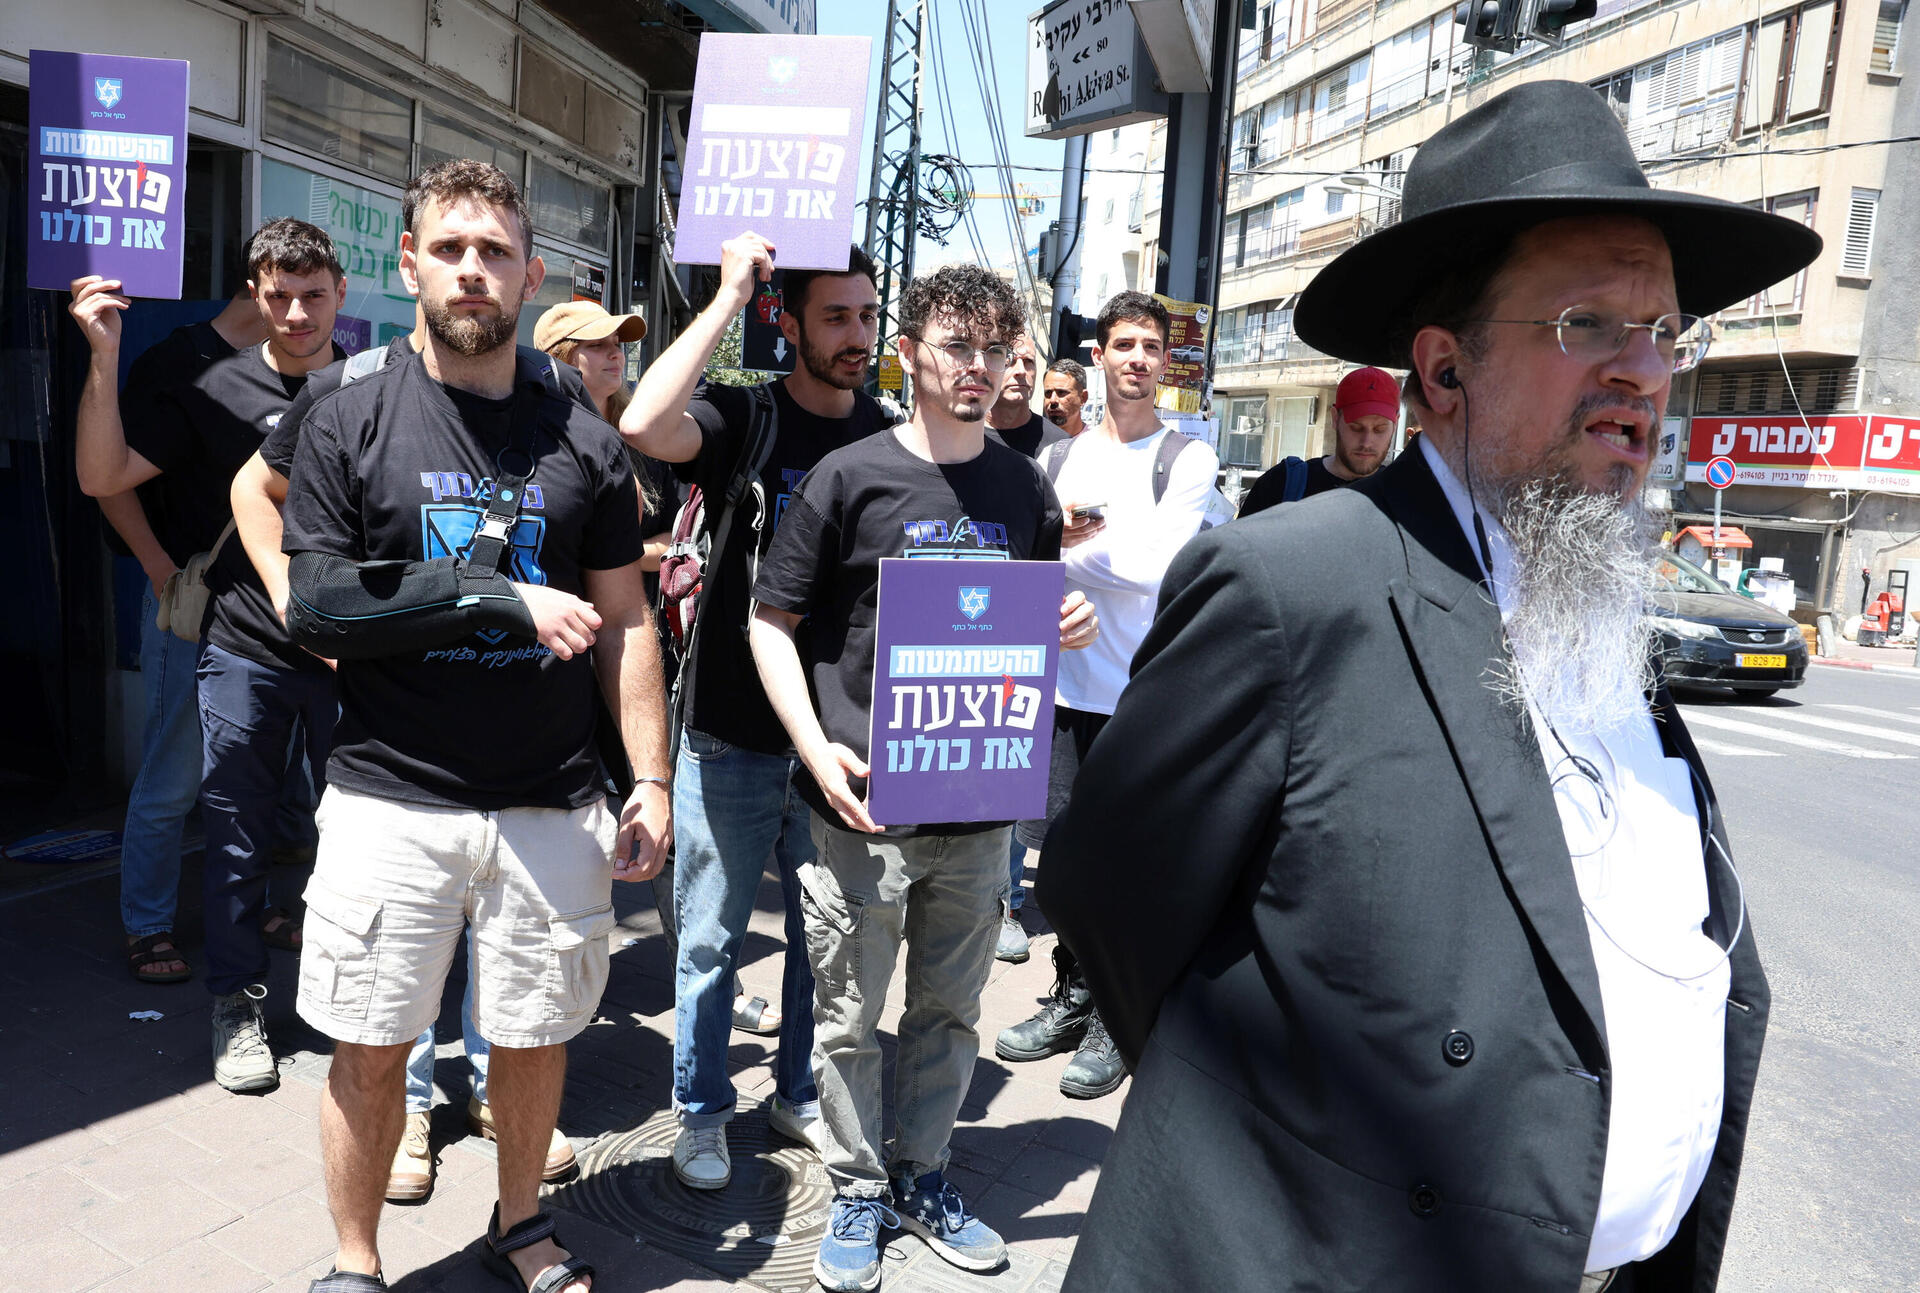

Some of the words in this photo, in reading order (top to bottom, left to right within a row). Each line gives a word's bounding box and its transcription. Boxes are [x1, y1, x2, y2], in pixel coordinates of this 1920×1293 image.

[1086, 0, 1111, 26] רבי
[1096, 37, 1109, 53] 80
[1033, 85, 1071, 118] Rbi
[1075, 70, 1114, 107] Akiva
[1116, 64, 1130, 85] St.
[45, 131, 168, 161] ההשתמטות
[697, 138, 845, 185] פוצעת
[41, 162, 171, 215] פוצעת
[694, 182, 775, 218] כולנו
[784, 189, 836, 220] את
[40, 209, 112, 246] כולנו
[121, 217, 166, 250] את
[1741, 426, 1836, 454] טמבור
[903, 519, 949, 547] כתף
[967, 520, 1008, 547] כתף
[951, 623, 967, 632] כתף
[967, 622, 977, 631] אל
[978, 623, 993, 632] כתף
[895, 649, 1040, 675] ההשתמטות
[888, 684, 1042, 732] פוצעת
[886, 735, 971, 773] כולנו
[981, 736, 1034, 770] את
